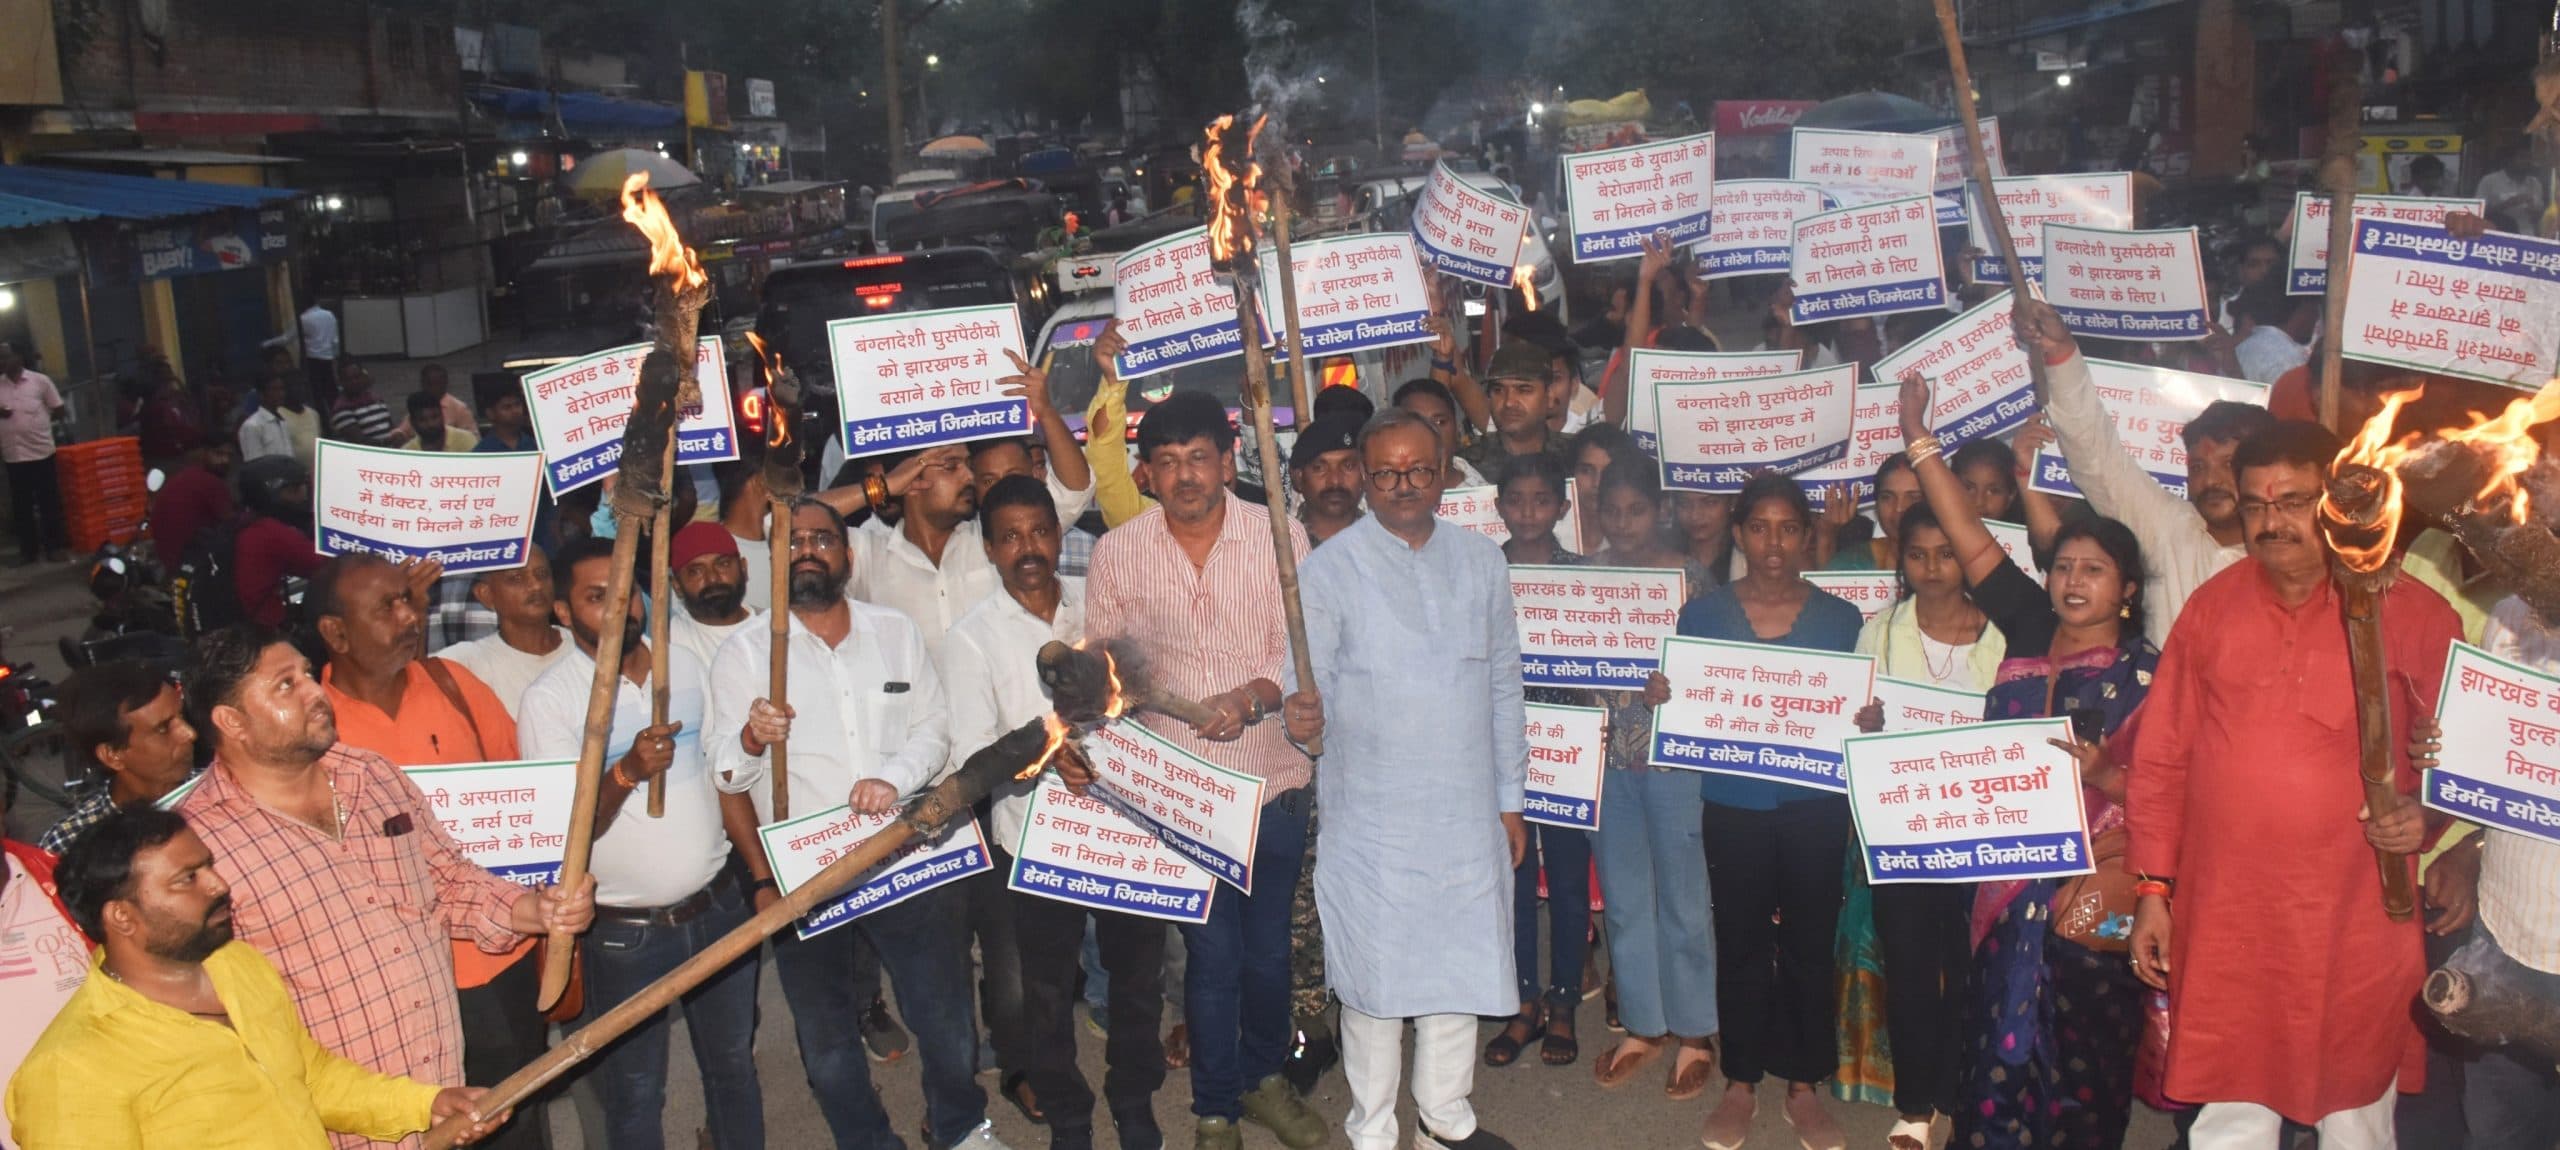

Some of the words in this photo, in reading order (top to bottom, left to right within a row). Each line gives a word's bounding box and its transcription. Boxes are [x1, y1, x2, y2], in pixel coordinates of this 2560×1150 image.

[1575, 157, 1626, 180] झारखंड
[1631, 153, 1644, 168] के
[1649, 145, 1689, 171] युवाओं
[1693, 140, 1707, 156] को
[1848, 166, 1861, 175] 16
[1597, 176, 1664, 198] बेरोजगारी
[1669, 172, 1693, 186] भत्ता
[1593, 211, 1609, 222] ना
[1615, 199, 1656, 220] मिलने
[1661, 197, 1673, 211] के
[1677, 193, 1699, 208] लिए
[1840, 214, 1852, 229] के
[1906, 202, 1925, 221] को
[1466, 219, 1494, 237] भत्ता
[1749, 228, 1759, 239] के
[1451, 233, 1464, 248] के
[1469, 238, 1497, 258] लिए
[1810, 237, 1872, 259] बेरोजगारी
[1880, 234, 1908, 249] भत्ता
[1438, 254, 1493, 278] जिम्मेदार
[1495, 269, 1506, 280] है
[1722, 251, 1752, 266] सोरेन
[1806, 271, 1821, 284] ना
[1825, 261, 1865, 281] मिलने
[1871, 259, 1884, 275] के
[1889, 257, 1918, 272] लिए
[2068, 264, 2083, 279] को
[2088, 267, 2144, 281] झारखण्ड
[2148, 266, 2160, 280] में
[1128, 275, 1187, 304] बेरोजगारी
[2070, 287, 2105, 301] बसाने
[2111, 287, 2123, 301] के
[2453, 280, 2469, 298] के
[2476, 282, 2527, 303] बसाने
[2390, 299, 2408, 319] में
[2413, 302, 2491, 327] झारखण्ड
[2085, 315, 2118, 329] सोरेन
[2122, 315, 2184, 331] जिम्मेदार
[2188, 313, 2199, 330] है
[2498, 314, 2520, 337] को
[854, 329, 926, 353] बंग्लादेशी
[932, 320, 1000, 351] घुसपैठीयों
[877, 360, 897, 378] को
[904, 355, 968, 375] झारखण्ड
[974, 348, 987, 367] में
[1125, 346, 1157, 369] हेमंत
[1158, 339, 1190, 359] सोरेन
[536, 366, 598, 400] झारखंड
[602, 357, 619, 376] के
[880, 385, 923, 405] बसाने
[930, 381, 945, 399] के
[854, 425, 892, 446] हेमंत
[896, 414, 936, 438] सोरेन
[940, 408, 1005, 433] जिम्मेदार
[1008, 404, 1022, 424] है
[1698, 416, 1719, 433] को
[1727, 414, 1794, 433] झारखण्ड
[1799, 407, 1815, 424] में
[2127, 417, 2147, 433] 16
[565, 427, 585, 443] ना
[1699, 440, 1745, 456] बसाने
[1752, 438, 1768, 454] के
[558, 455, 594, 482] हेमंत
[713, 433, 725, 450] है
[358, 469, 422, 488] सरकारी
[430, 475, 501, 488] अस्पताल
[359, 489, 373, 504] में
[440, 495, 468, 510] नर्स
[473, 495, 495, 510] एवं
[392, 521, 410, 531] ना
[416, 518, 463, 533] मिलने
[469, 516, 483, 529] के
[490, 515, 519, 528] लिए
[503, 542, 519, 559] है
[1512, 579, 1566, 596] झारखंड
[1572, 580, 1585, 597] के
[1592, 582, 1641, 604] युवाओं
[1647, 585, 1668, 601] को
[1524, 607, 1558, 621] लाख
[1565, 609, 1621, 624] सरकारी
[1628, 607, 1676, 626] नौकरी
[1528, 632, 1547, 645] ना
[1552, 629, 1597, 647] मिलने
[1604, 634, 1618, 648] के
[1624, 632, 1656, 649] लिए
[1552, 660, 1592, 676] सोरेन
[1704, 664, 1746, 680] उत्पाद
[1752, 665, 1803, 686] सिपाही
[1808, 672, 1828, 689] की
[2461, 666, 2540, 709] झारखंड
[1686, 687, 1715, 702] भर्ती
[1721, 689, 1733, 704] में
[1742, 694, 1763, 708] 16
[1770, 695, 1847, 717] युवाओं
[1547, 723, 1565, 739] की
[1705, 714, 1723, 730] की
[1730, 716, 1757, 733] मौत
[1765, 719, 1779, 733] के
[1786, 720, 1816, 739] लिए
[1662, 739, 1705, 757] हेमंत
[1709, 744, 1755, 763] सोरेन
[1759, 748, 1834, 774] जिम्मेदार
[1890, 758, 1936, 775] उत्पाद
[1940, 746, 1996, 770] सिपाही
[2002, 742, 2025, 761] की
[1107, 757, 1125, 776] को
[1131, 771, 1194, 808] झारखण्ड
[1199, 798, 1214, 818] में
[1529, 767, 1555, 785] लिए
[1879, 784, 1909, 805] भर्ती
[1915, 783, 1930, 801] में
[1939, 781, 1963, 799] 16
[1969, 765, 2052, 804] युवाओं
[459, 788, 536, 806] अस्पताल
[2440, 780, 2499, 812] हेमंत
[1153, 801, 1168, 817] के
[1576, 803, 1589, 820] है
[1907, 815, 1928, 832] की
[1933, 809, 1967, 829] मौत
[1975, 808, 1989, 826] के
[1995, 806, 2028, 825] लिए
[1035, 813, 1045, 826] 5
[1052, 816, 1091, 836] लाख
[503, 834, 523, 850] के
[531, 833, 563, 848] लिए
[1051, 843, 1070, 857] ना
[1077, 843, 1126, 868] मिलने
[1132, 856, 1148, 872] के
[1154, 859, 1186, 879] लिए
[1877, 851, 1919, 871] हेमंत
[1924, 848, 1972, 869] सोरेन
[1976, 842, 2058, 865] जिम्मेदार
[2060, 838, 2077, 861] है
[848, 885, 891, 911] सोरेन
[892, 856, 963, 892] जिम्मेदार
[964, 850, 978, 866] है
[1023, 866, 1064, 887] हेमंत
[1066, 878, 1109, 897] सोरेन
[1114, 884, 1186, 908] जिम्मेदार
[1187, 894, 1201, 912] है
